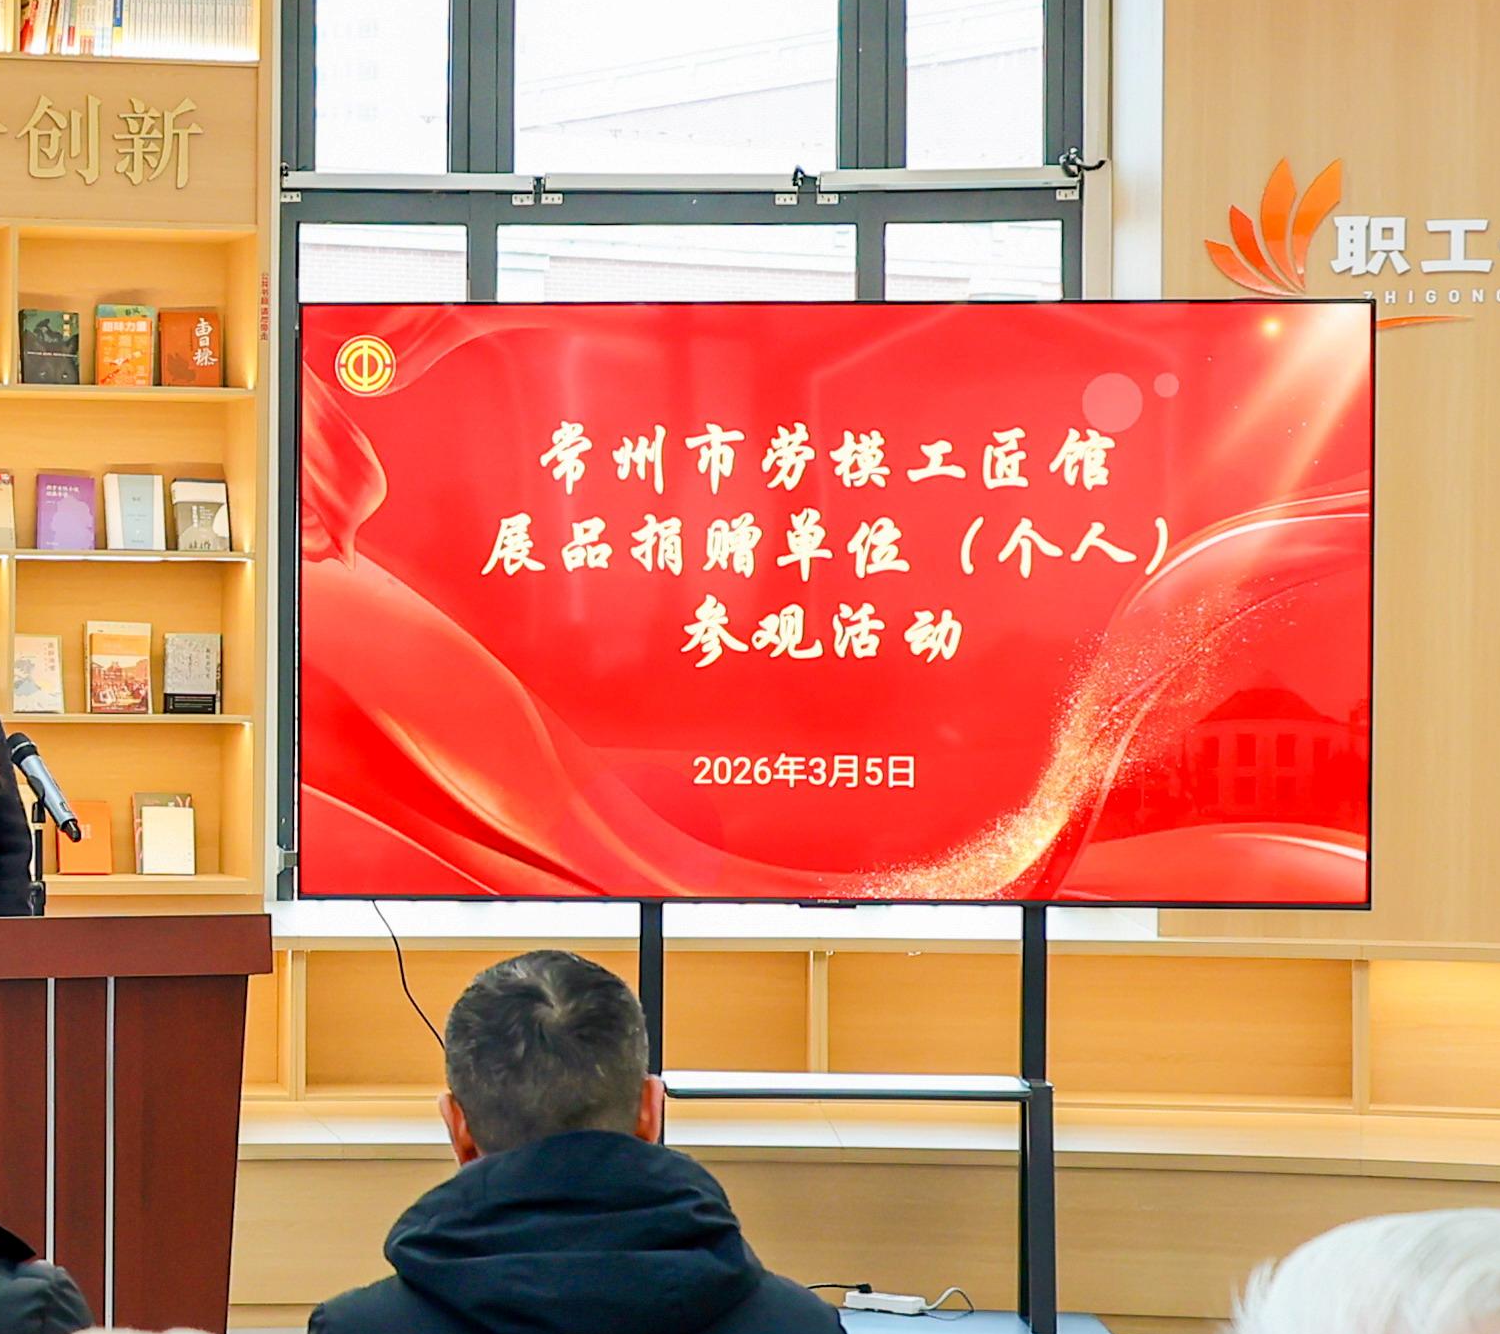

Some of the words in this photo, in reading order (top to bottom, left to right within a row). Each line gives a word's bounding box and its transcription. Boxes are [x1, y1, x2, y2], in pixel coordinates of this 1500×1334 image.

[538, 420, 1117, 496] 常州市劳模工匠馆
[678, 602, 964, 669] 参观活动
[691, 752, 916, 792] 2026年3月5日
